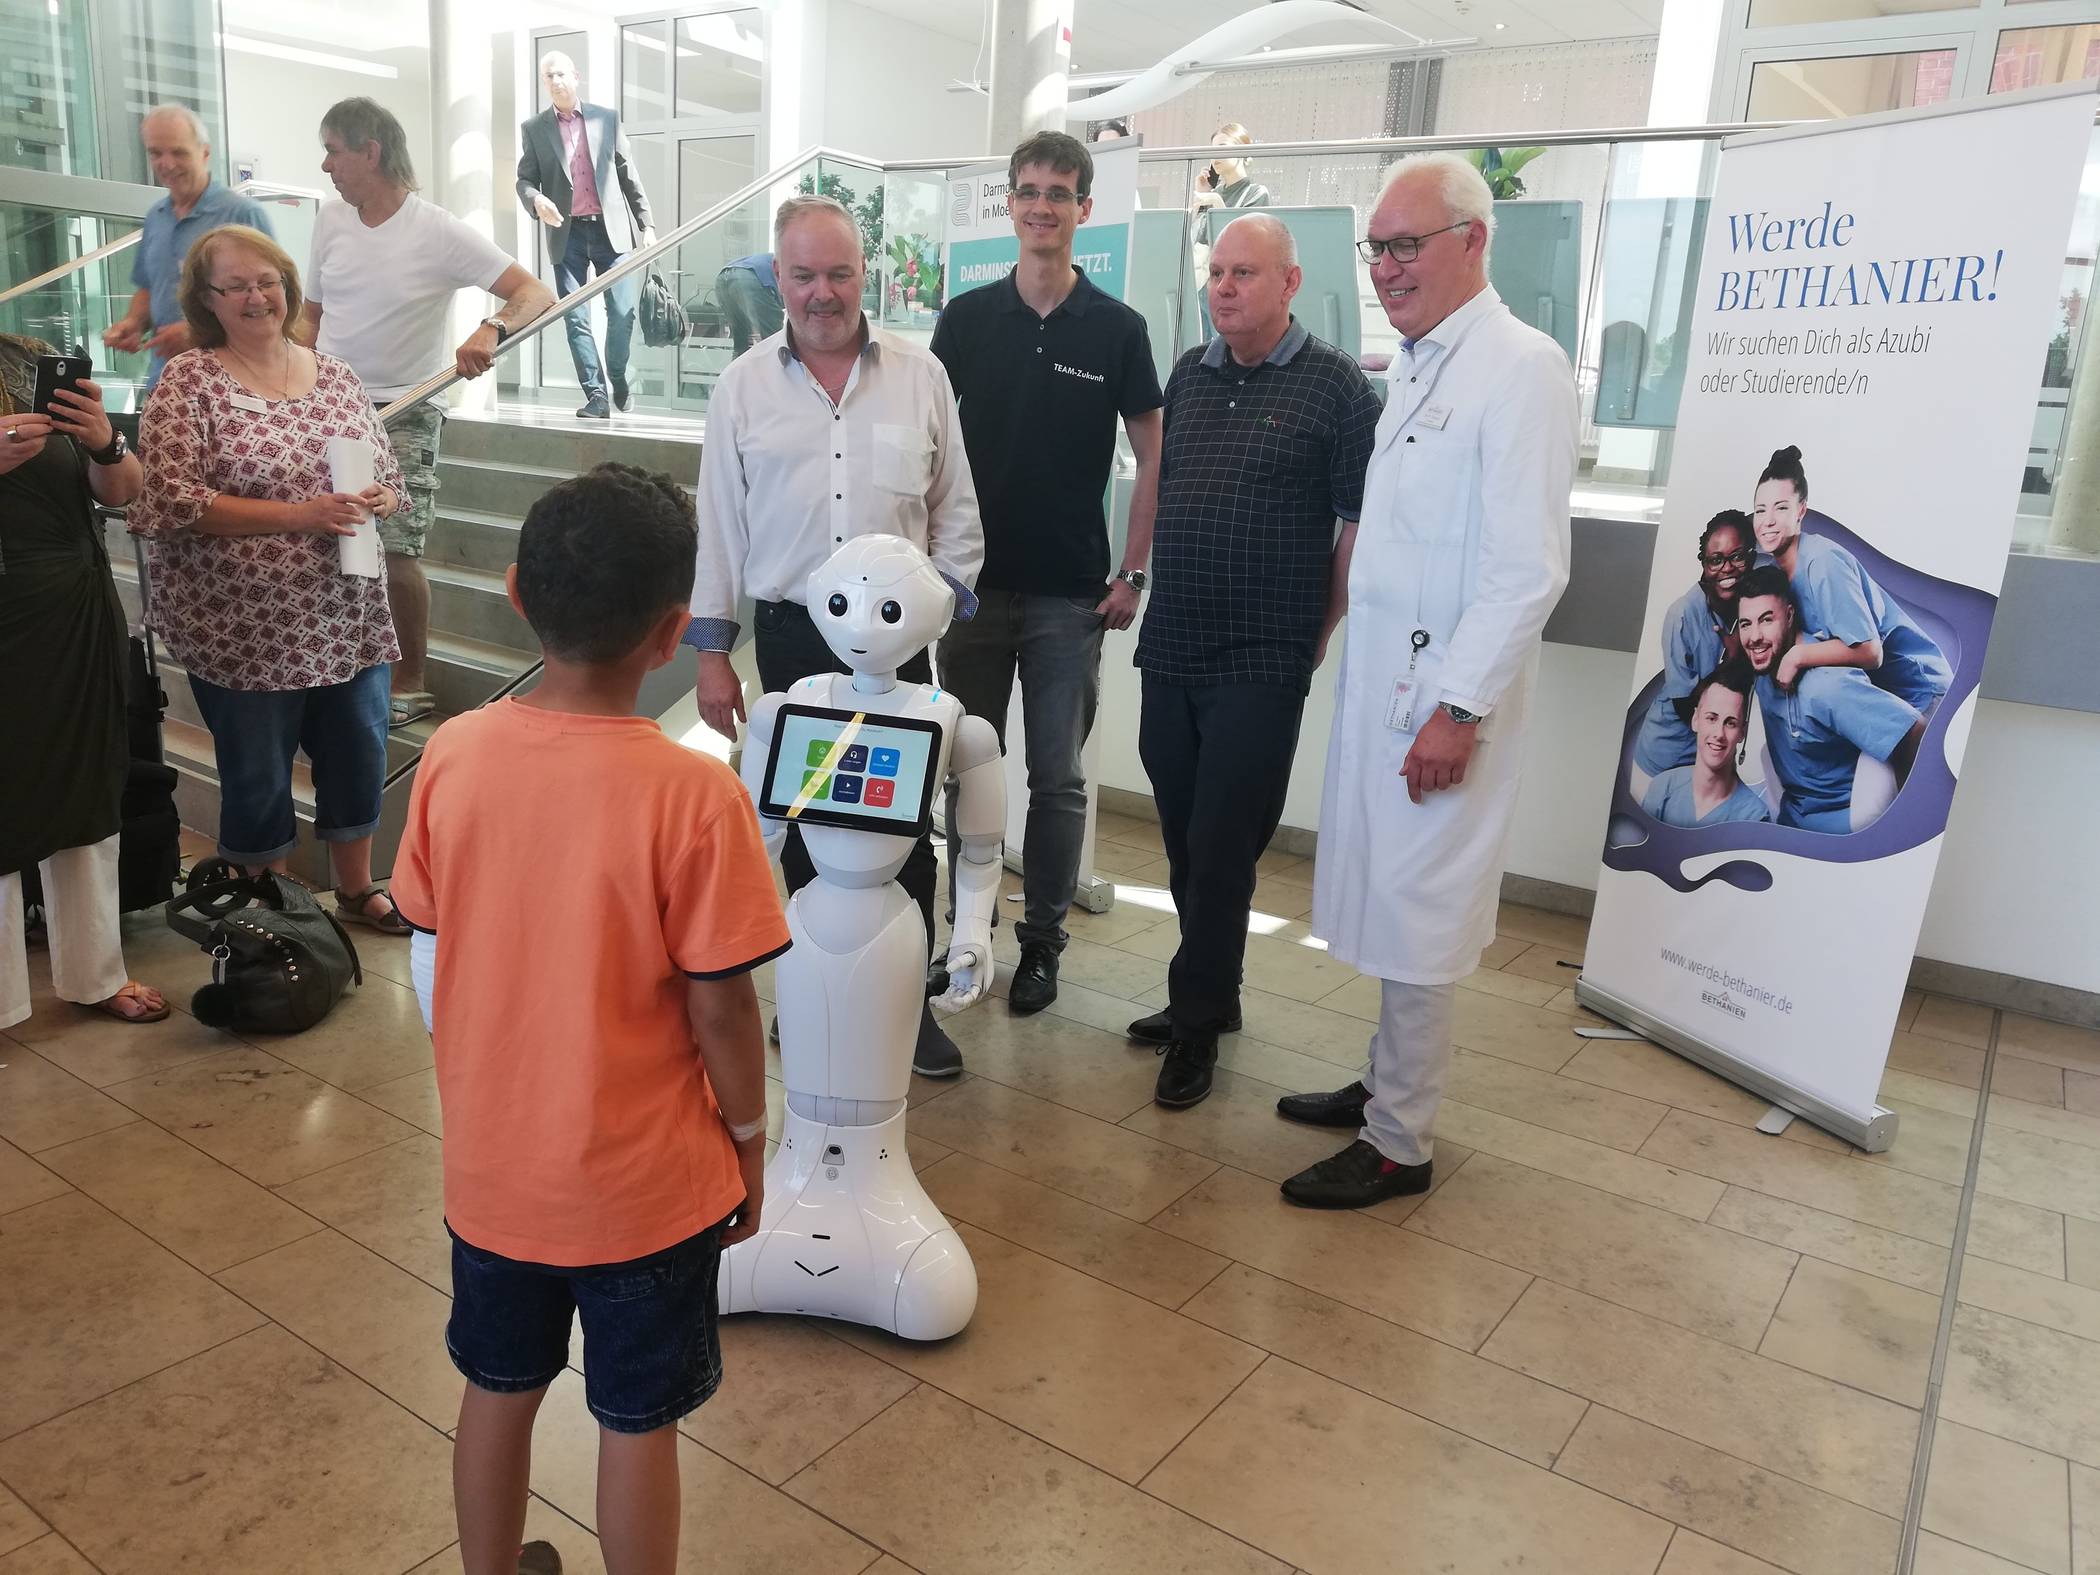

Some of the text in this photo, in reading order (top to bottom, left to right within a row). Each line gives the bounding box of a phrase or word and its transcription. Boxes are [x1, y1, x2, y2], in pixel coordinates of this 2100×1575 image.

[982, 205, 990, 219] in
[1728, 201, 1855, 254] Werde
[1714, 249, 2004, 312] BETHANIER!
[1707, 325, 1932, 355] Wir suchen Dich als Azubi
[1054, 363, 1105, 383] TEAM-Zukunft
[1700, 368, 1869, 395] oder Studierende/n
[1660, 947, 1793, 1014] www.werde-bethanier.de
[1701, 992, 1746, 1018] BETHANIEN
